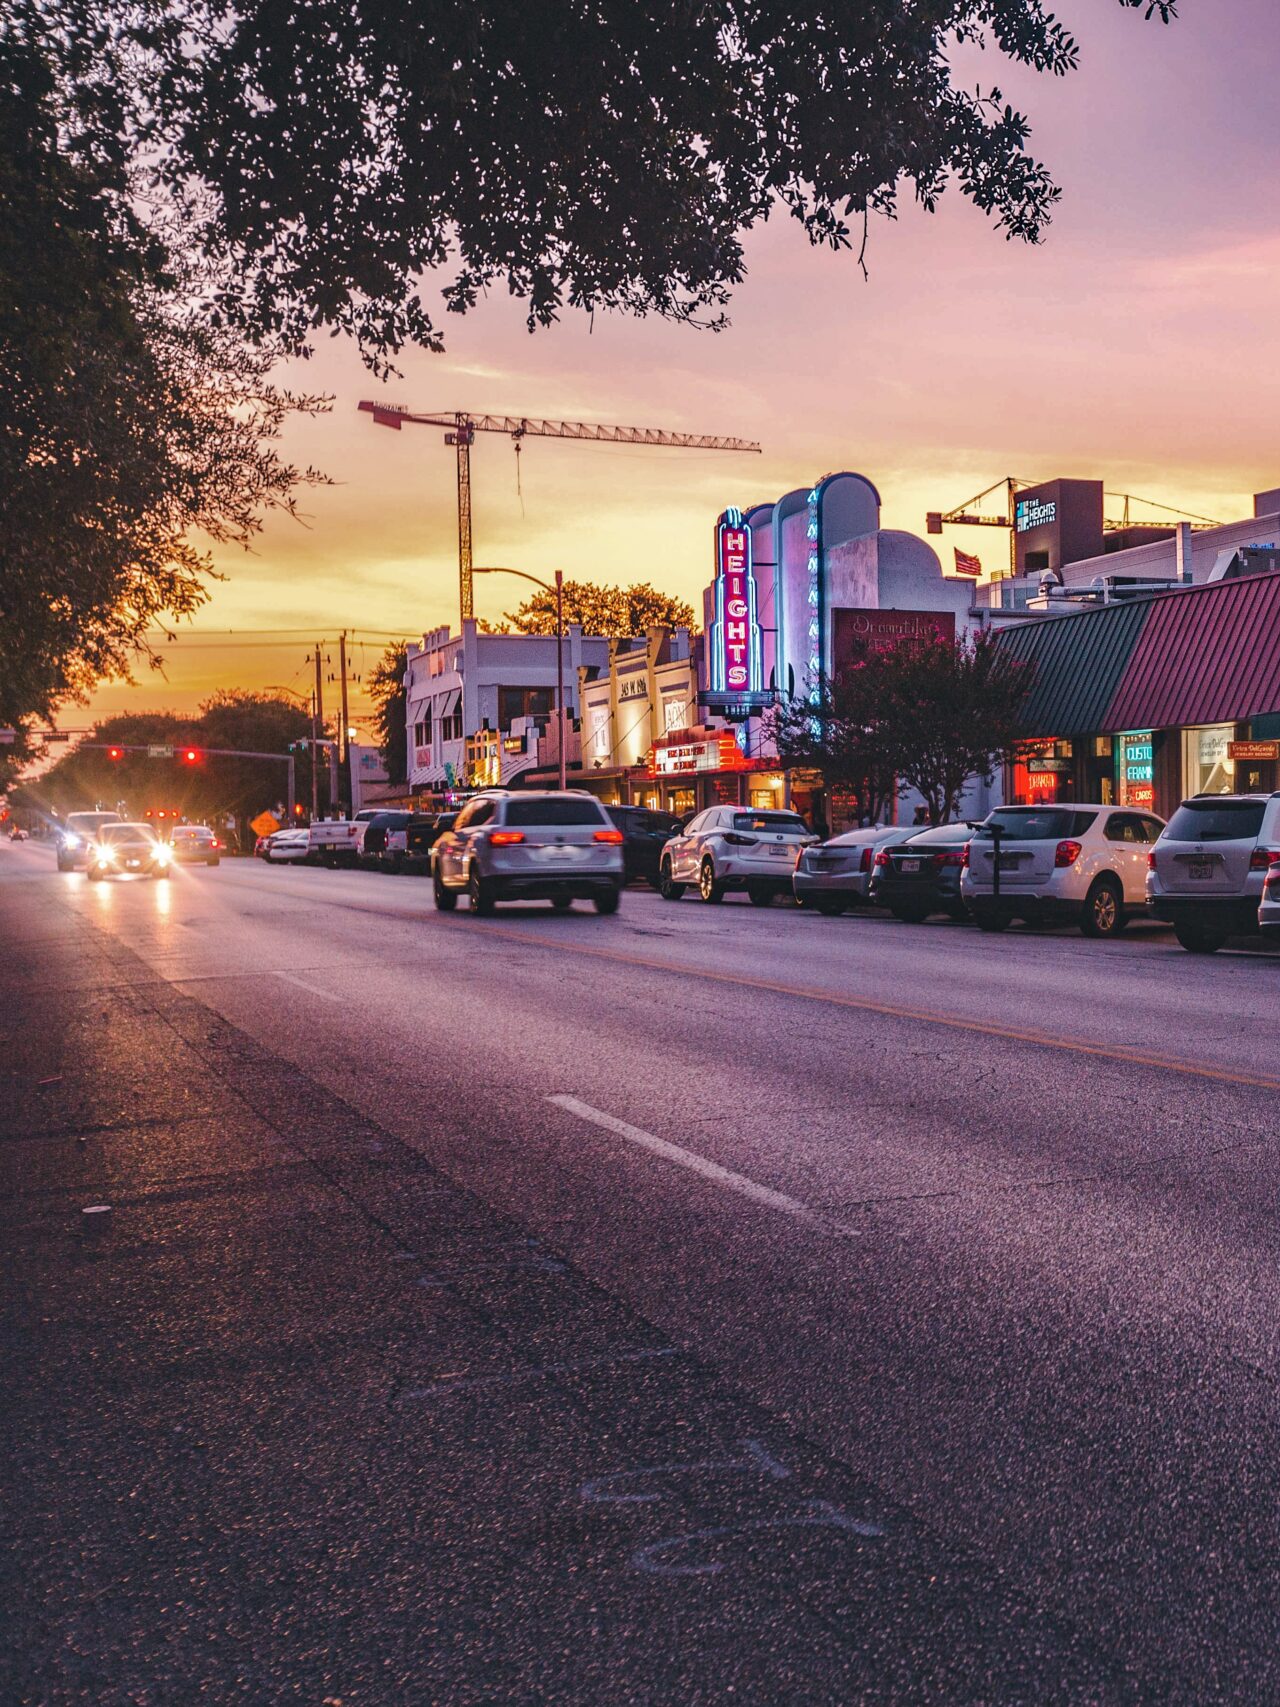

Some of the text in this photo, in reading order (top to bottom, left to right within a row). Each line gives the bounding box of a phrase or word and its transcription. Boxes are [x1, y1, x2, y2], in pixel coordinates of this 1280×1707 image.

[1029, 499, 1039, 507] THE
[1029, 502, 1056, 520] HEIGHTS
[727, 532, 748, 685] HEIGHTS
[1127, 746, 1152, 760] CUSTO
[1136, 790, 1153, 801] CARDS
